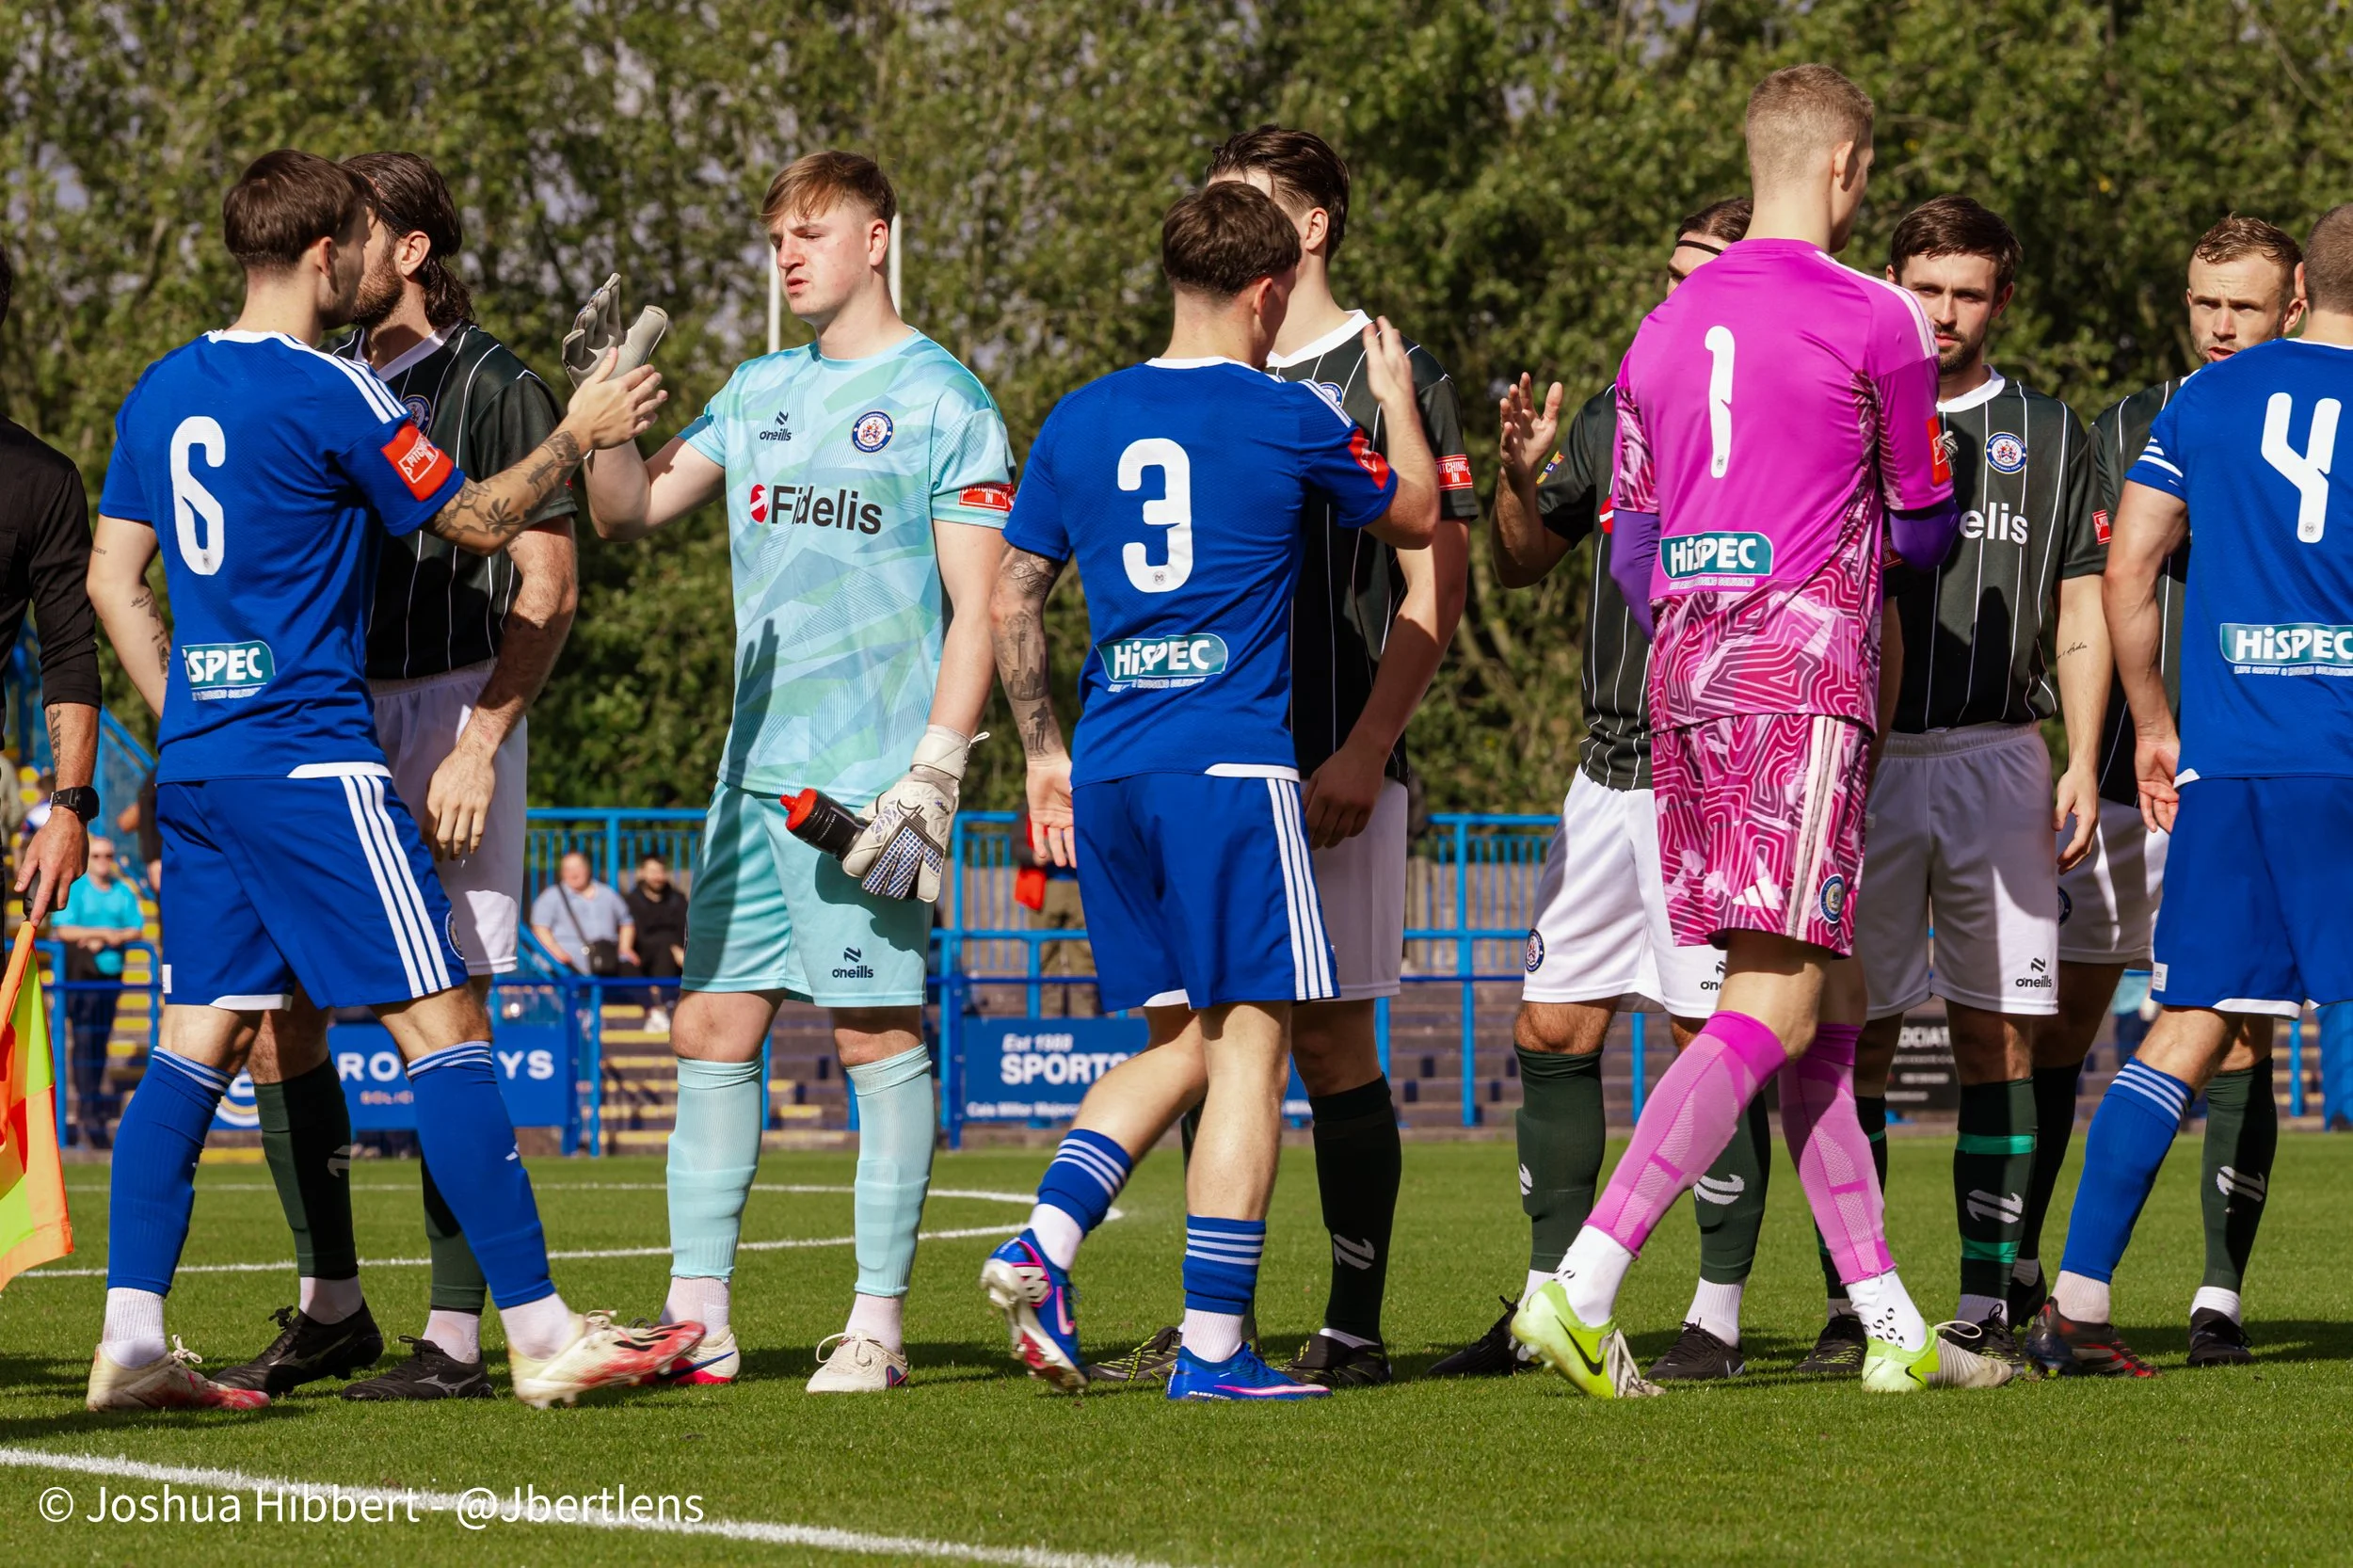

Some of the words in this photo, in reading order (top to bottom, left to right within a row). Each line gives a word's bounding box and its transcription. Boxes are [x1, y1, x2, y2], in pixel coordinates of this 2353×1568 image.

[1705, 325, 1736, 478] 1
[2261, 392, 2342, 544] 4
[169, 415, 226, 576] 6
[771, 485, 883, 536] Fidelis
[1117, 438, 1193, 593] 3
[1959, 502, 2028, 545] elis
[1670, 536, 1757, 578] HiSPEC
[1112, 639, 1211, 680] HiSPEC
[2234, 626, 2353, 662] HiSPEC
